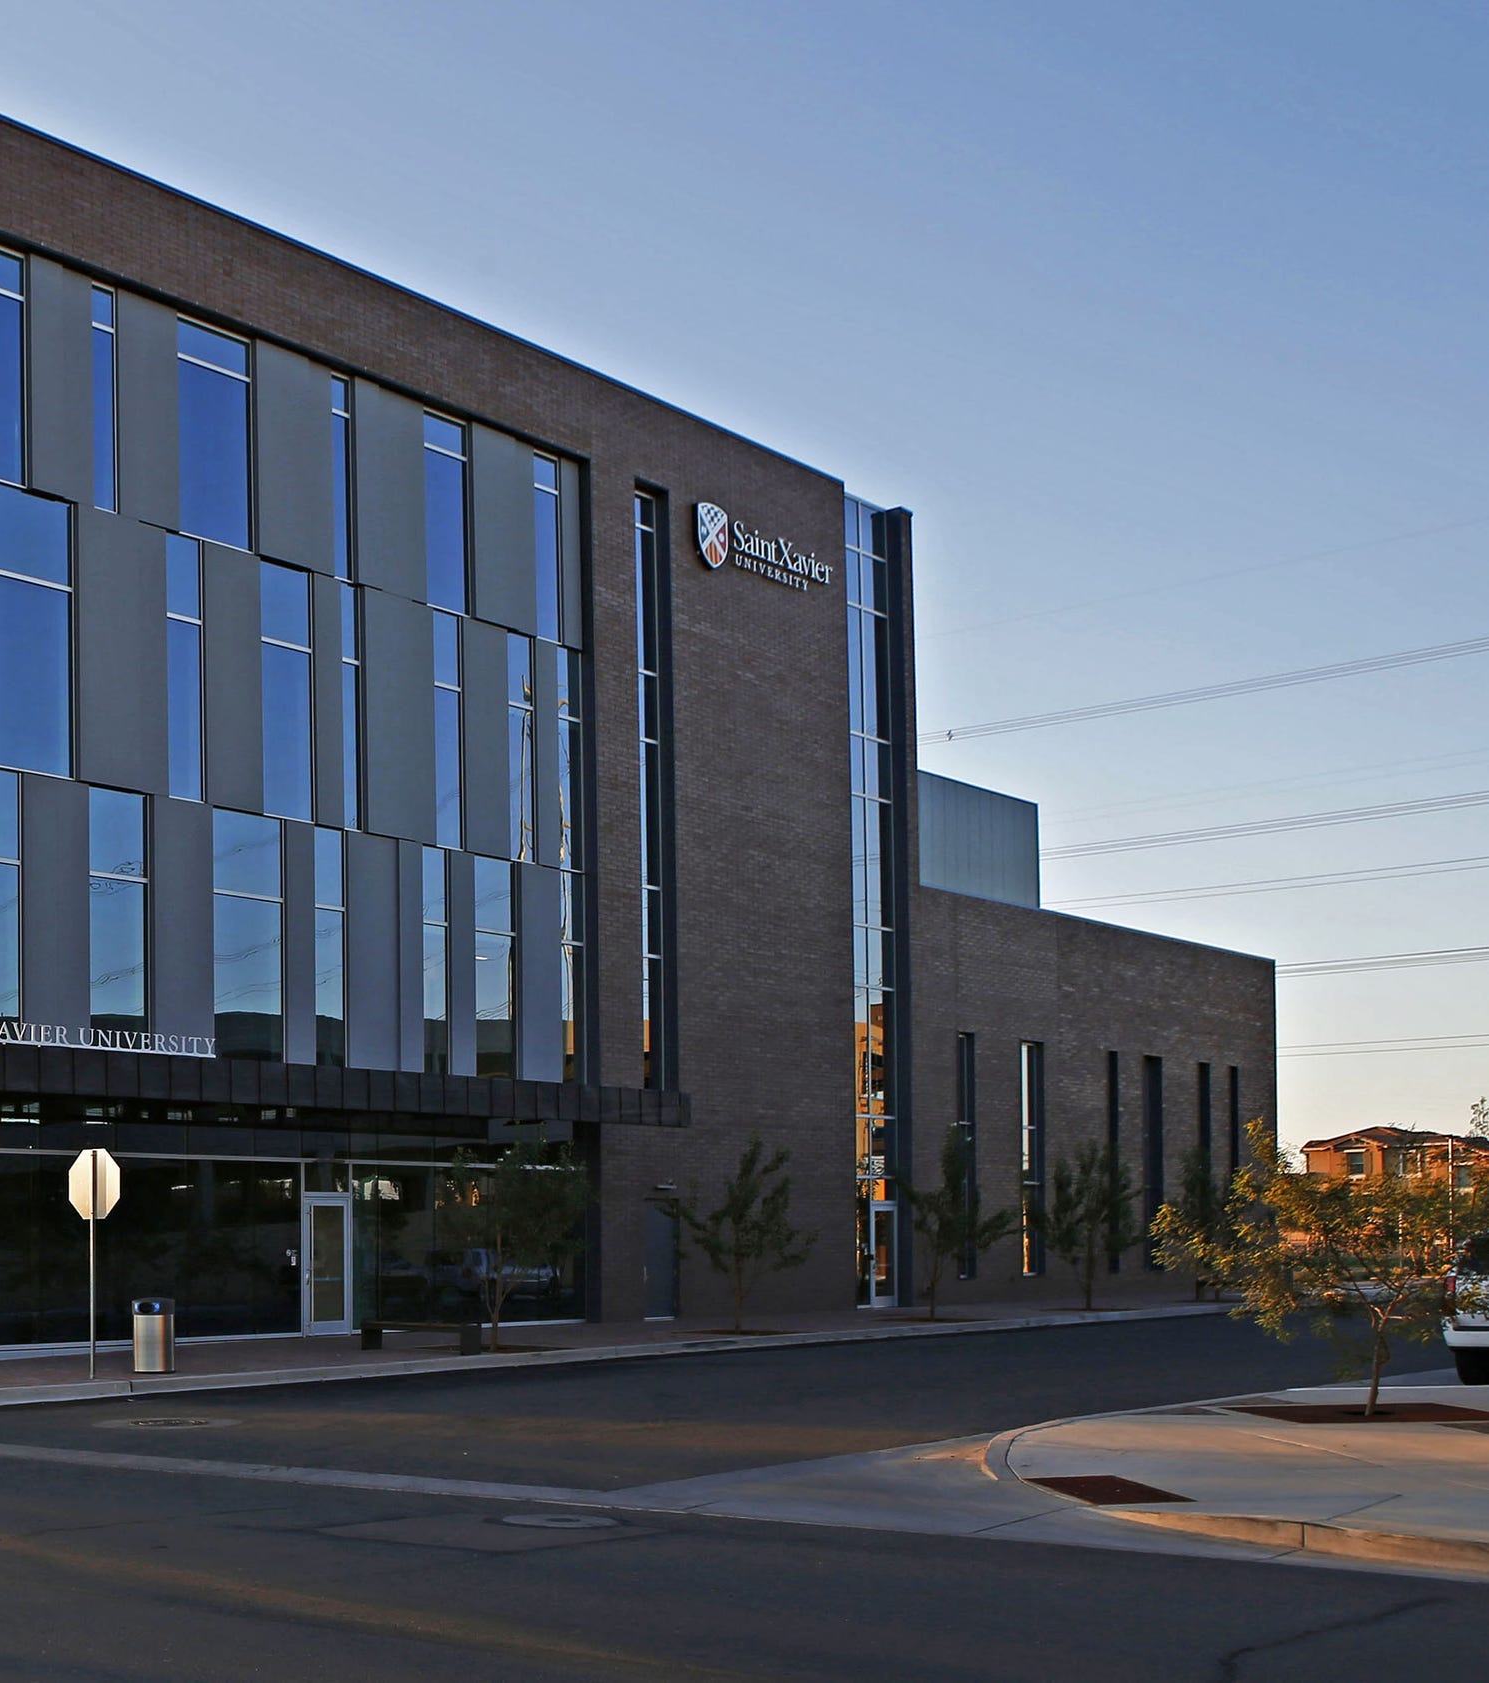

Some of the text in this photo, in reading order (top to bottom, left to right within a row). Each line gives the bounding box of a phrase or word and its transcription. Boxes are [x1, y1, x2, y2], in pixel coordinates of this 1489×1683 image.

[733, 520, 834, 584] Saint Xavier
[734, 554, 809, 592] UNIVERSITY
[78, 1028, 217, 1056] UNIVERSITY
